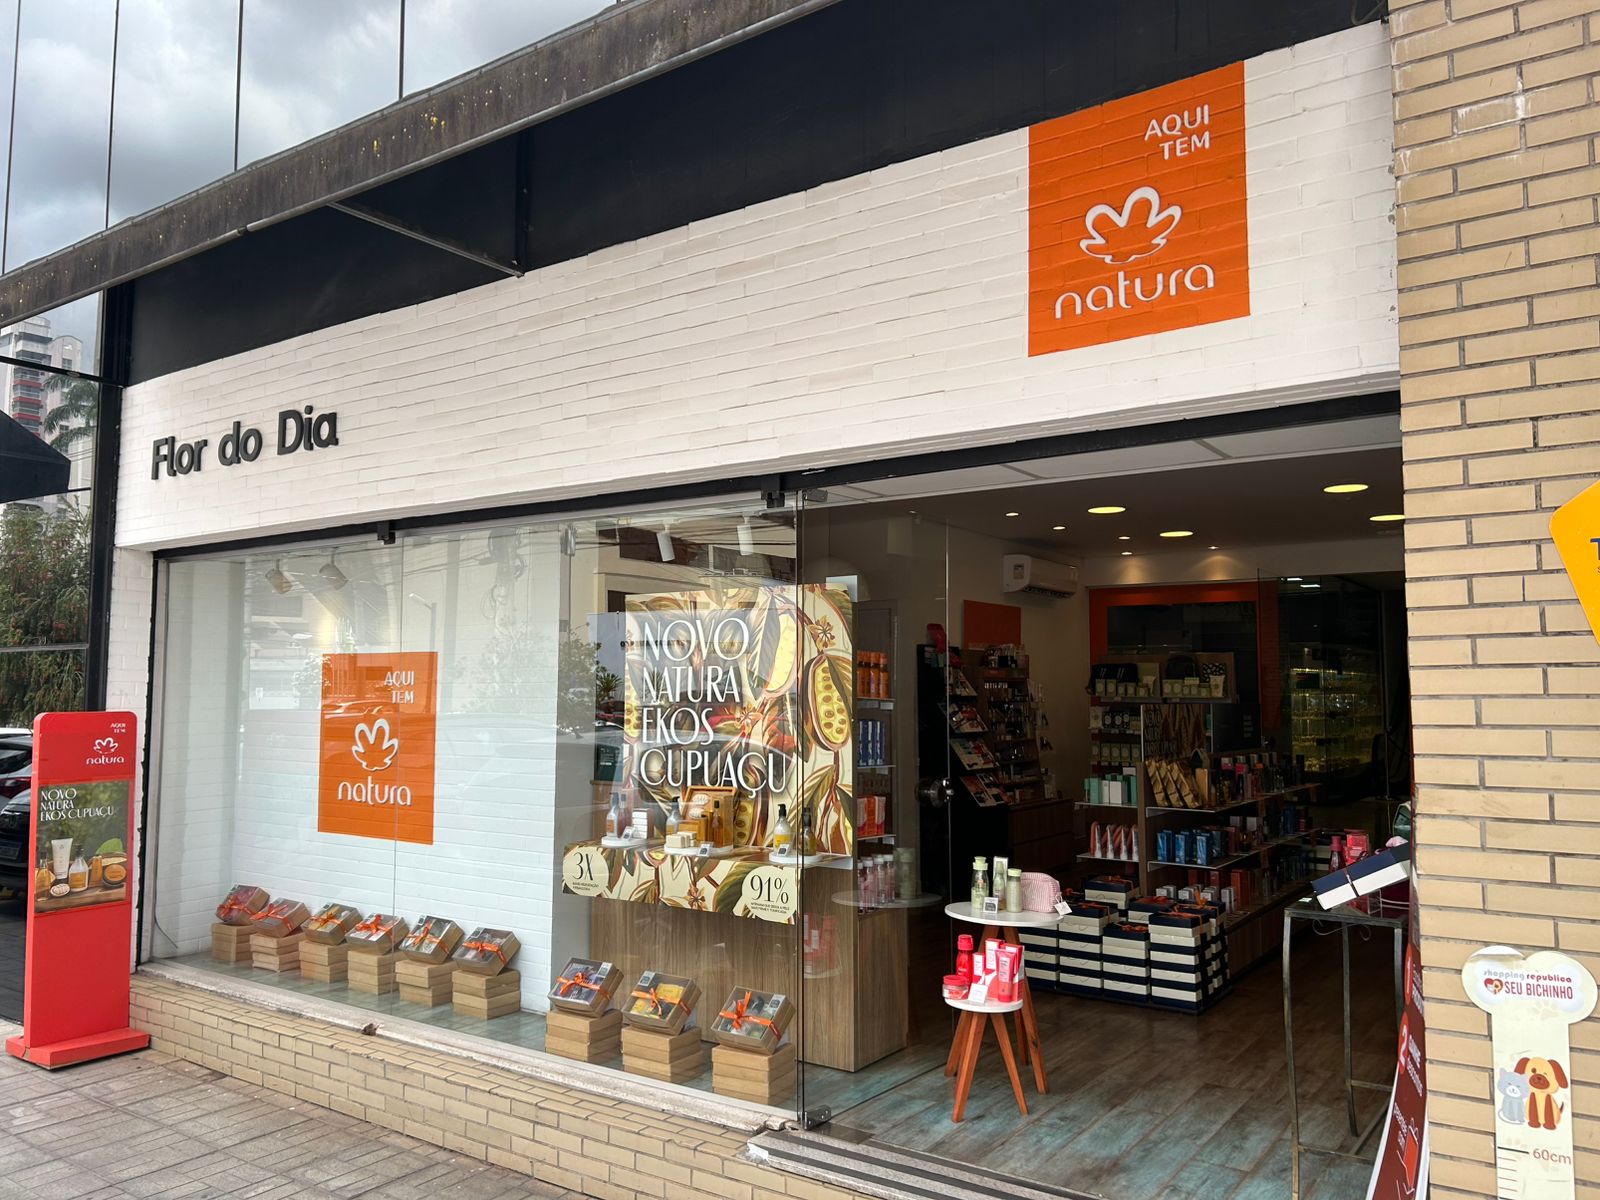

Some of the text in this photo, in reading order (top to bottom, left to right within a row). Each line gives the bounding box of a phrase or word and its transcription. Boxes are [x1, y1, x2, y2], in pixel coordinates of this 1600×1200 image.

[1144, 104, 1210, 141] AQUI
[1159, 131, 1211, 160] TEM
[1055, 264, 1215, 319] natura
[151, 405, 339, 480] Flor do Dia
[642, 618, 750, 662] NOVO
[384, 671, 415, 686] AQUI
[641, 665, 741, 704] NATURA
[391, 690, 414, 704] TEM
[641, 707, 714, 746] EKOS
[85, 756, 125, 766] natura
[640, 748, 787, 799] CUPUAÇU
[41, 787, 77, 802] NOVO
[338, 776, 412, 806] natura
[40, 800, 75, 812] NATURA
[40, 806, 114, 822] EKOS CUPUAÇU
[572, 851, 594, 881] 3X
[750, 874, 789, 905] 91%
[1483, 969, 1573, 984] shopping republica
[1504, 981, 1574, 1000] SEU BICHINHO
[1532, 1147, 1572, 1165] 60cm
